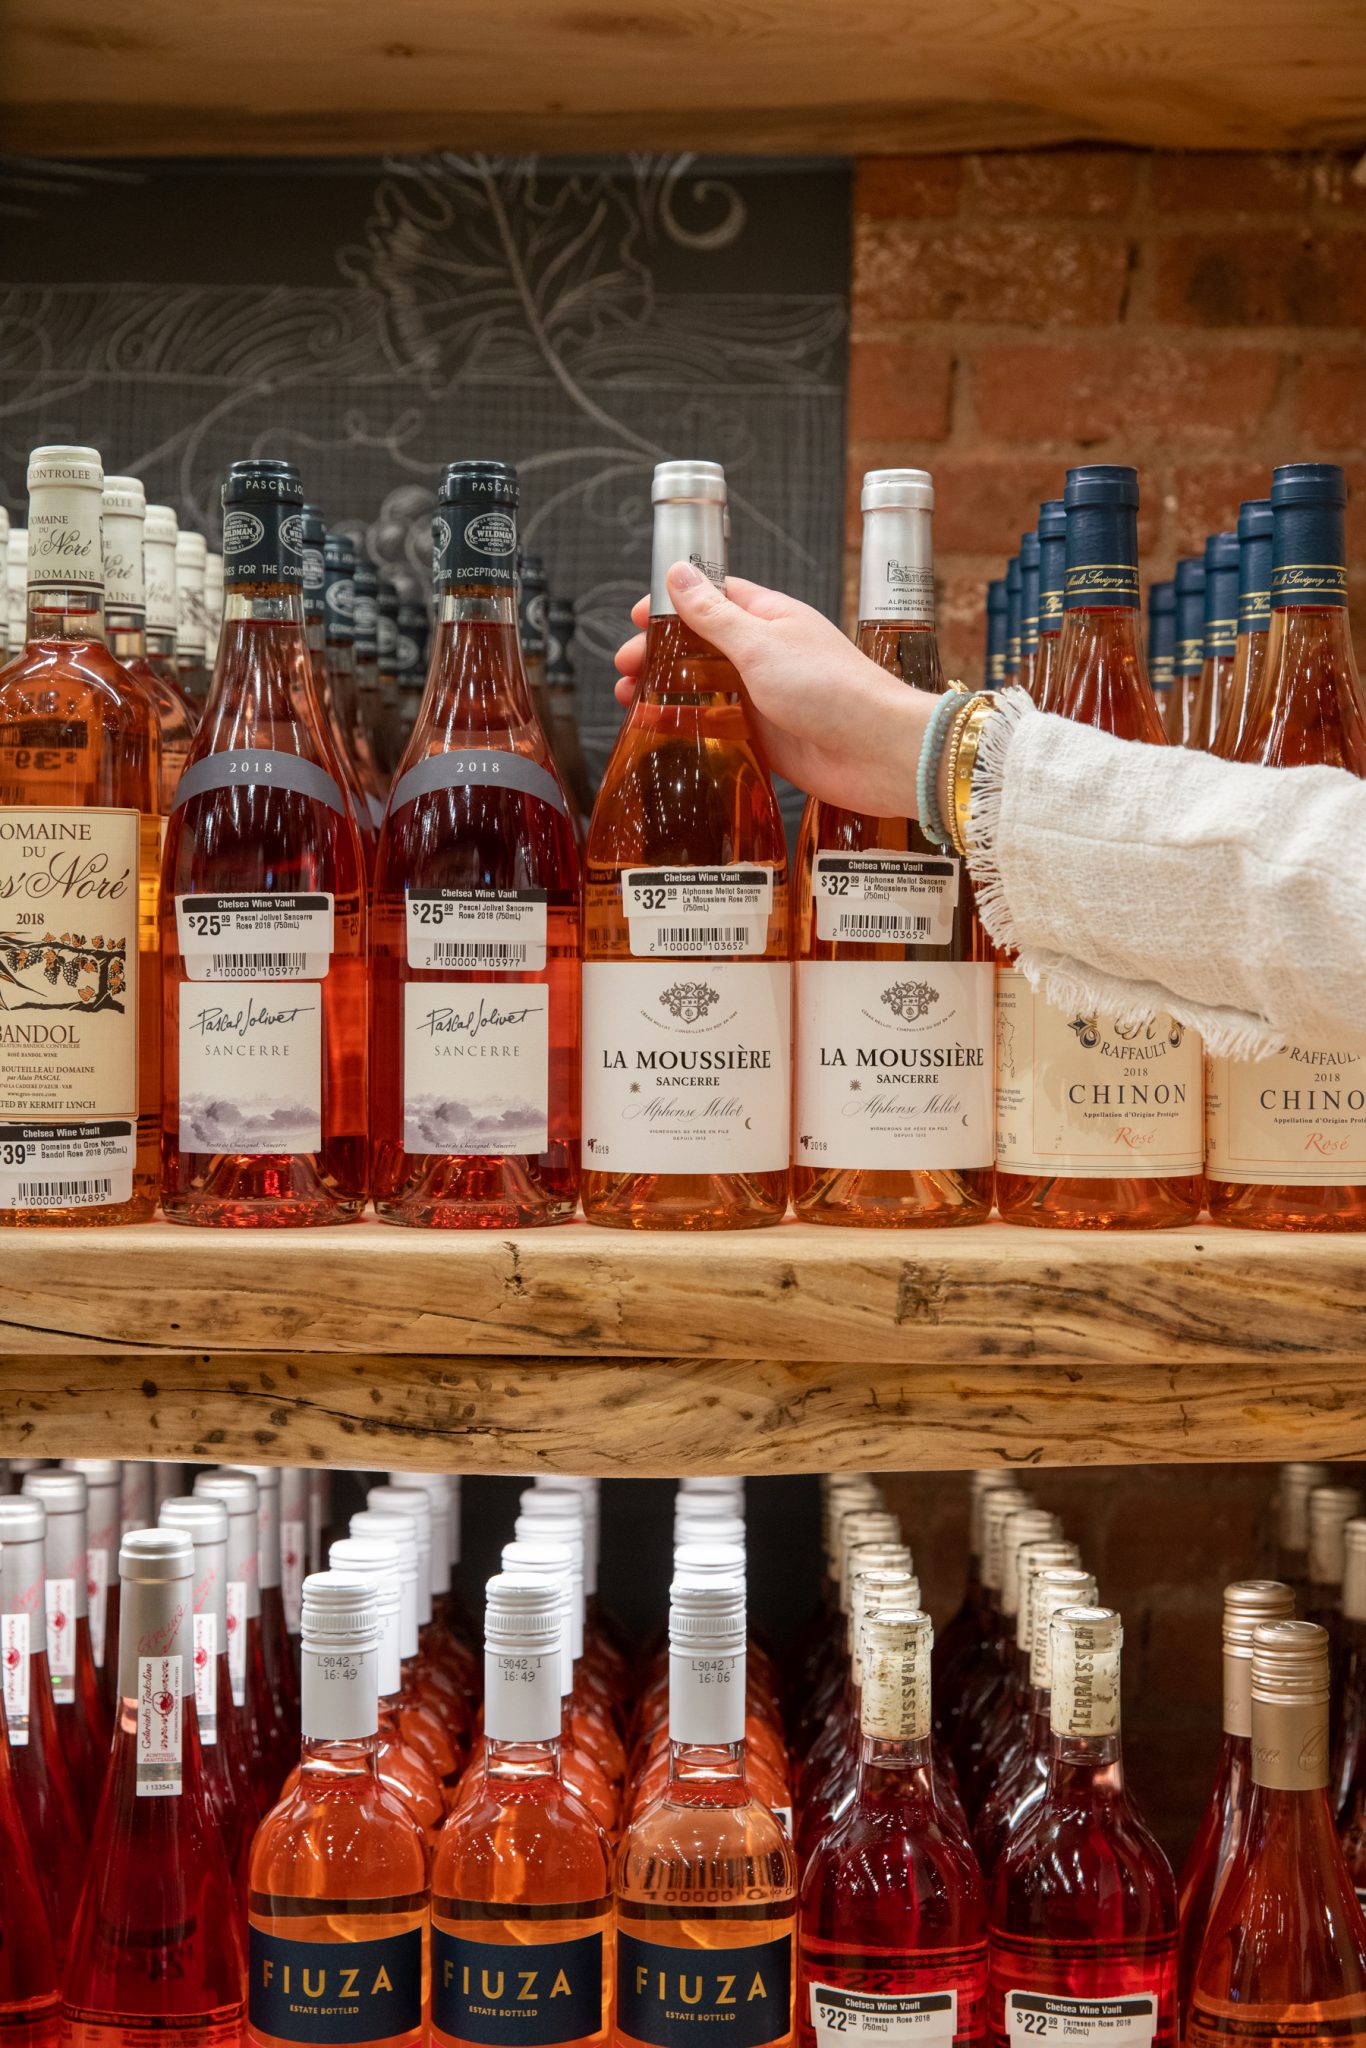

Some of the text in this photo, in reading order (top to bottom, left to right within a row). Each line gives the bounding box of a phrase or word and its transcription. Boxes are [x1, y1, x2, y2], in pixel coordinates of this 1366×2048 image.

[245, 480, 291, 492] PASCAL
[472, 482, 514, 494] PASCAL
[34, 570, 95, 580] DOMAINE
[238, 565, 257, 574] FOR
[262, 565, 278, 574] THE
[456, 568, 511, 579] EXCEPTIONAL
[229, 762, 272, 773] 2018
[456, 762, 500, 773] 2018
[0, 824, 92, 841] OMAINE
[22, 847, 46, 858] DU
[848, 861, 924, 872] Chelsea Wine Vault
[664, 873, 740, 882] Chelsea Wine Vault
[441, 889, 518, 898] Chelsea Wine Vault
[218, 899, 296, 908] Chelsea Wine Vault
[16, 913, 45, 925] 2018
[236, 922, 253, 930] Rose
[845, 929, 925, 940] 100000 103652
[664, 942, 744, 951] 100000 103652
[440, 958, 520, 967] 100000 105977
[219, 967, 300, 977] 100000 105977
[205, 1044, 290, 1057] SANCERRE
[434, 1045, 520, 1057] SANCERRE
[819, 1042, 984, 1067] LA MOUSSIÈRE
[1100, 1041, 1168, 1060] RAFFAULT
[602, 1044, 771, 1070] LA MOUSSIÈRE
[1123, 1067, 1149, 1077] 2018
[1314, 1072, 1341, 1082] 2018
[656, 1076, 720, 1087] SANCERRE
[876, 1074, 939, 1084] SANCERRE
[1068, 1084, 1186, 1104] CHINON
[1260, 1089, 1366, 1110] CHINO
[30, 1101, 63, 1109] KERMIT
[66, 1101, 96, 1109] LYNCH
[622, 1096, 697, 1122] Alphonse
[841, 1094, 917, 1118] Alphonse
[23, 1127, 101, 1138] Chelsea Wine Vault
[1113, 1127, 1157, 1150] Rosé
[84, 1141, 99, 1149] Gros
[810, 1141, 828, 1151] 2018
[1304, 1132, 1351, 1156] Rosé
[24, 1193, 106, 1205] 100000 104895
[323, 1669, 358, 1681] 16:49
[504, 1670, 536, 1682] 16:49
[698, 1671, 731, 1684] 16:06
[1068, 1627, 1095, 1731] TERRASSEN
[263, 1960, 393, 1998] FIUZA
[444, 1960, 572, 2000] FIUZA
[636, 1966, 767, 2004] FIUZA
[289, 2004, 359, 2015] ESTATE BOTTLED
[845, 1998, 921, 2011] Chelsea Wine Vault
[1045, 2002, 1122, 2015] Chelsea Wine Vault
[468, 2005, 538, 2017] ESTATE BOTTLED
[665, 2010, 736, 2021] ESTATE BOTTLED
